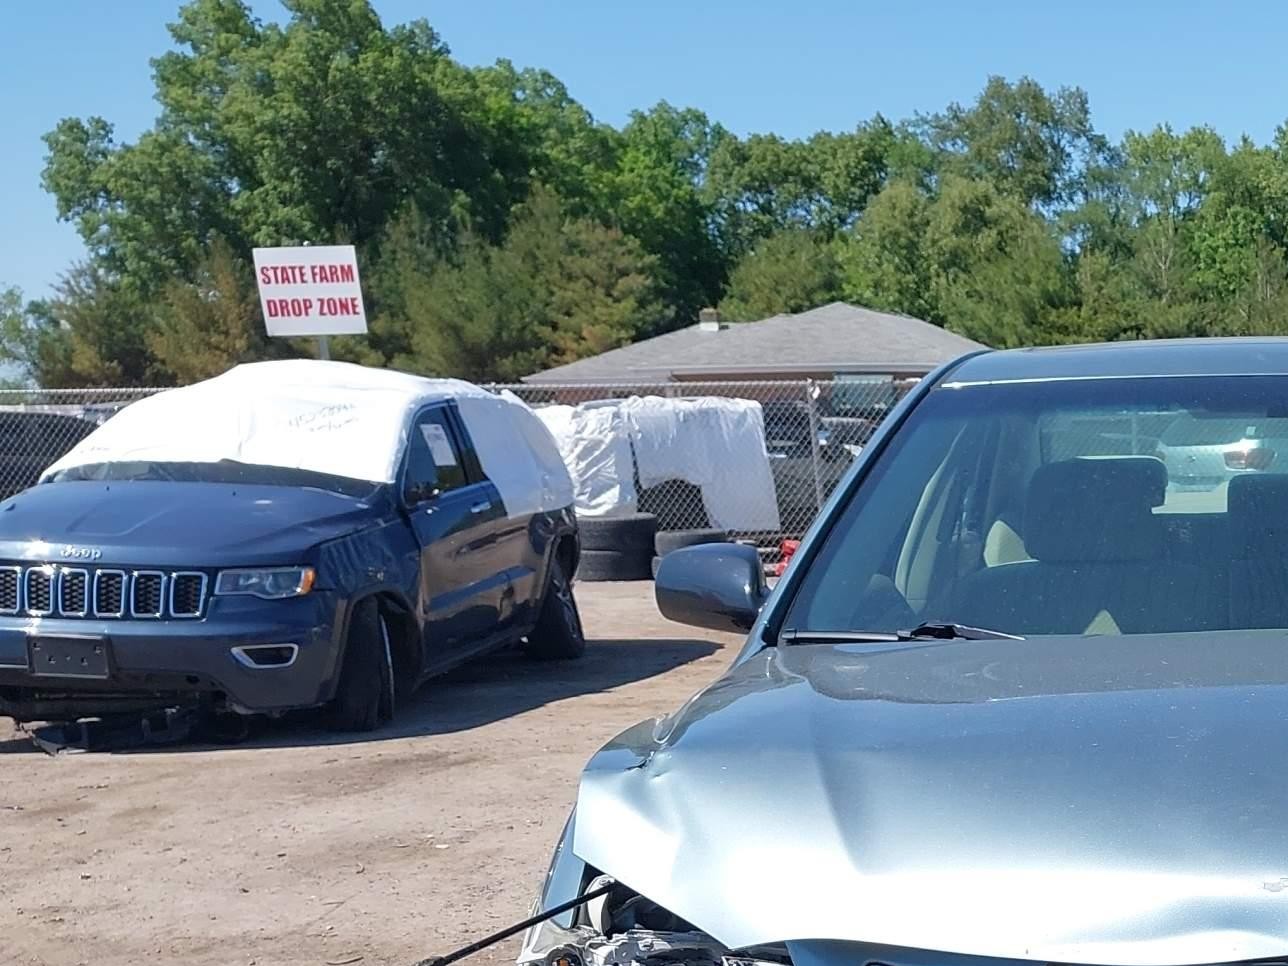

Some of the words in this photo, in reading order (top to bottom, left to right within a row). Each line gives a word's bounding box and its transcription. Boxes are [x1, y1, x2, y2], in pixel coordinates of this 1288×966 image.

[260, 265, 308, 285] STATE
[310, 264, 355, 283] FARM
[266, 298, 313, 318] DROP
[316, 297, 361, 317] ZONE
